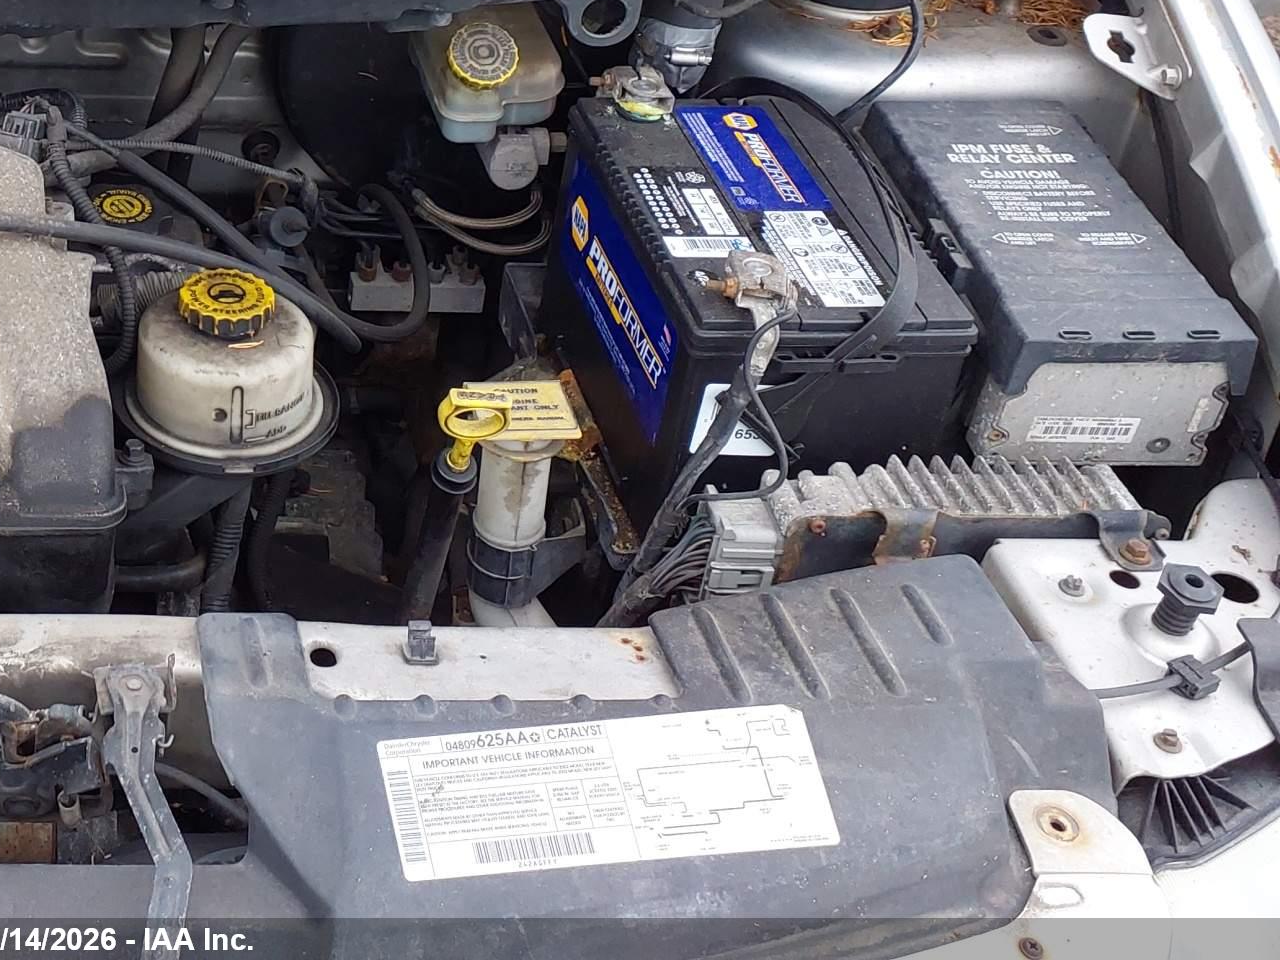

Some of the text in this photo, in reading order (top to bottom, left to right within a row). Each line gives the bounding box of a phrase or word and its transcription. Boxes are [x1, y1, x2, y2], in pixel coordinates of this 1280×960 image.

[947, 153, 1077, 163] RELAY CENTER
[952, 144, 1052, 154] IPM FUSE &
[741, 132, 803, 202] PROFORMER
[980, 170, 1060, 179] CAUTION!
[589, 239, 661, 384] PROFORMER
[445, 725, 603, 751] 04809625AA CATALYST
[423, 746, 595, 769] IMPORTANT VEHICLE INFORMATION
